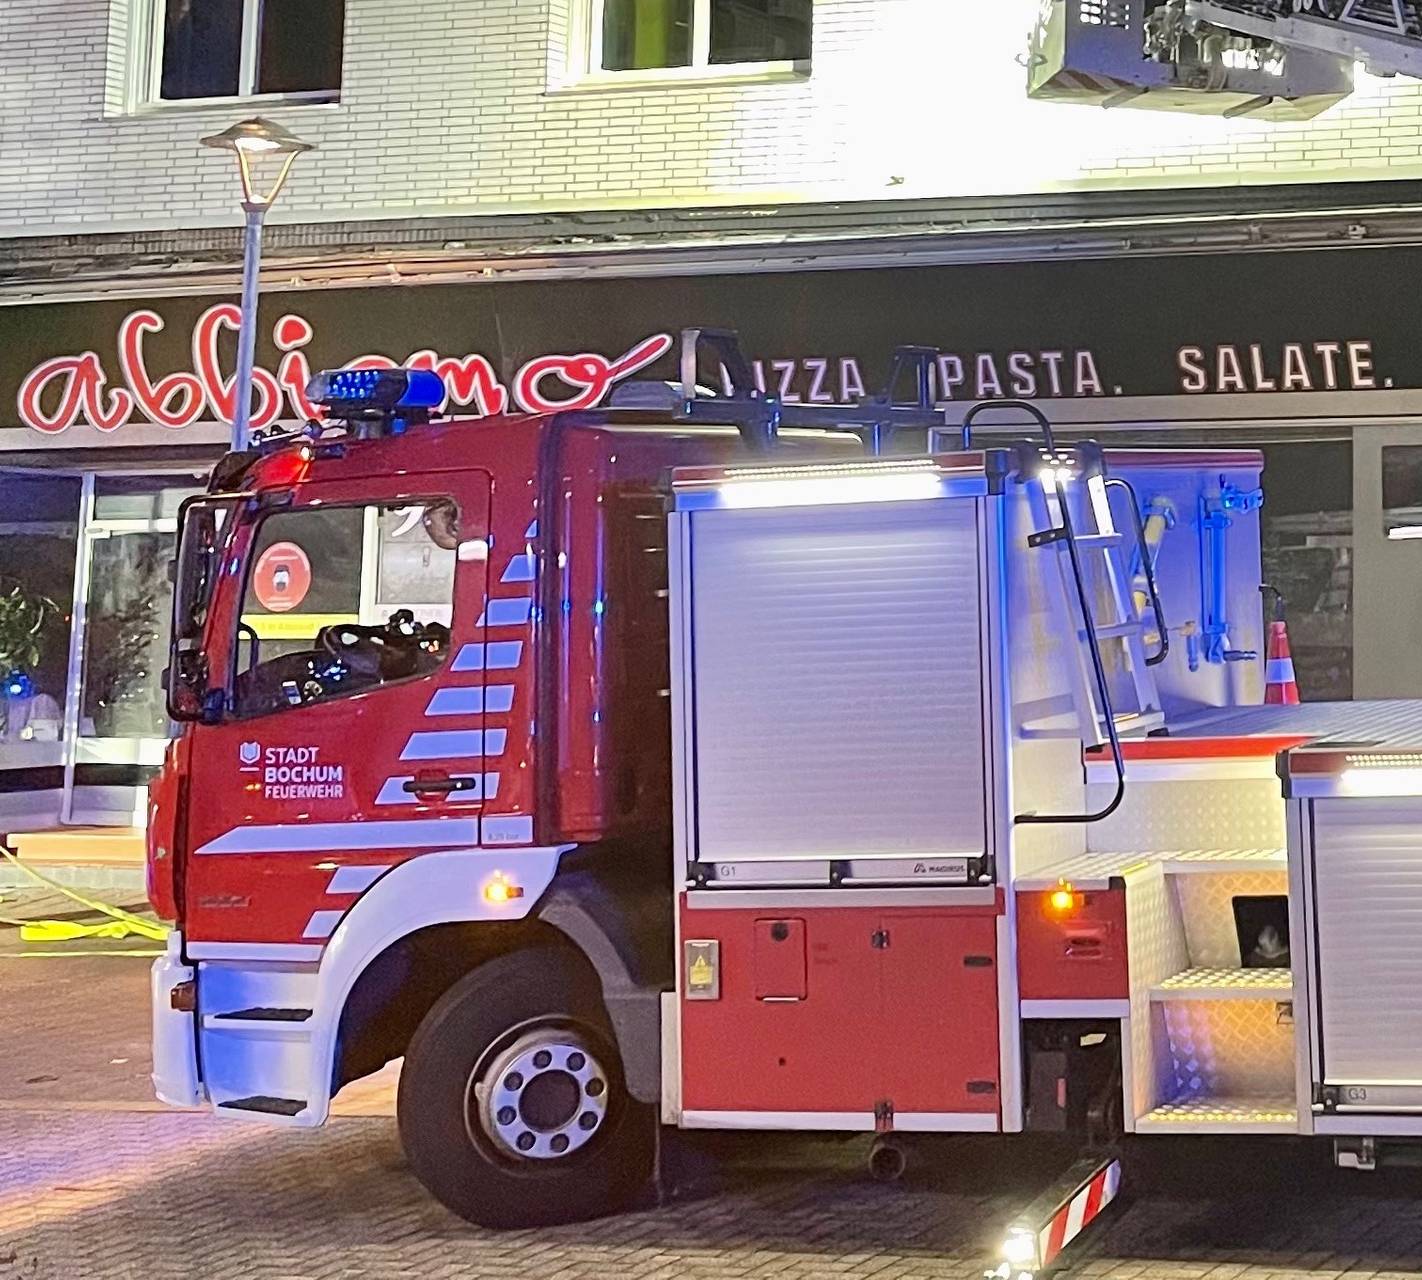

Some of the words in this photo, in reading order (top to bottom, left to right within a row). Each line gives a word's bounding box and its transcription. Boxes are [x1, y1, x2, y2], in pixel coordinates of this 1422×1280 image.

[17, 303, 673, 434] abbimo
[936, 349, 1123, 399] PASTA.
[1177, 340, 1394, 393] SALATE.
[265, 747, 320, 764] STADT
[264, 765, 344, 783] BOCHUM
[264, 784, 344, 799] FEUERWEHR
[1348, 1087, 1367, 1101] G3
